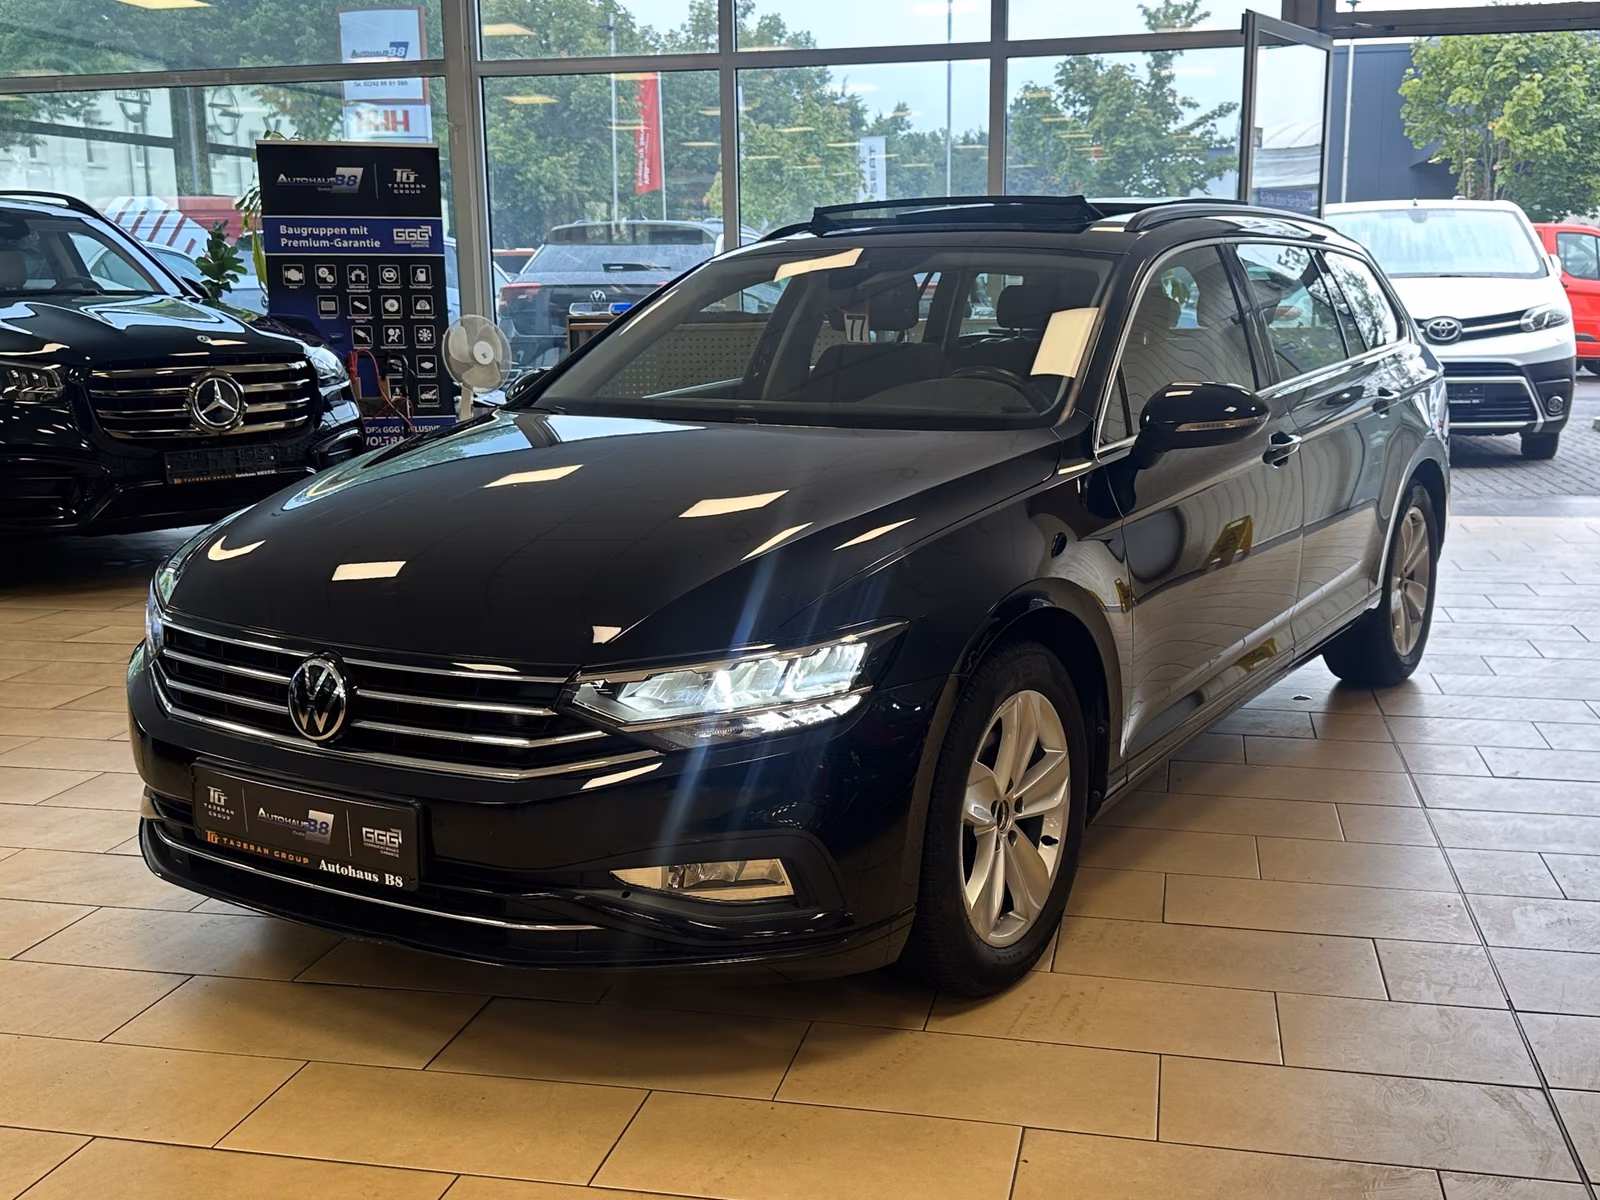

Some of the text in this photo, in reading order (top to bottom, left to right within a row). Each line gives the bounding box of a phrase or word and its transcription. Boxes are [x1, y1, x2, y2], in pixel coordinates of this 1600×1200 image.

[279, 225, 369, 236] Baugruppen mit
[280, 238, 381, 248] Premium-Garantie
[208, 810, 231, 821] GROUP
[257, 807, 330, 836] AUTOHAUS B8
[222, 837, 269, 855] TAJERAN
[273, 850, 309, 864] GROUP
[319, 859, 379, 883] Autohaus
[384, 873, 404, 888] B8
